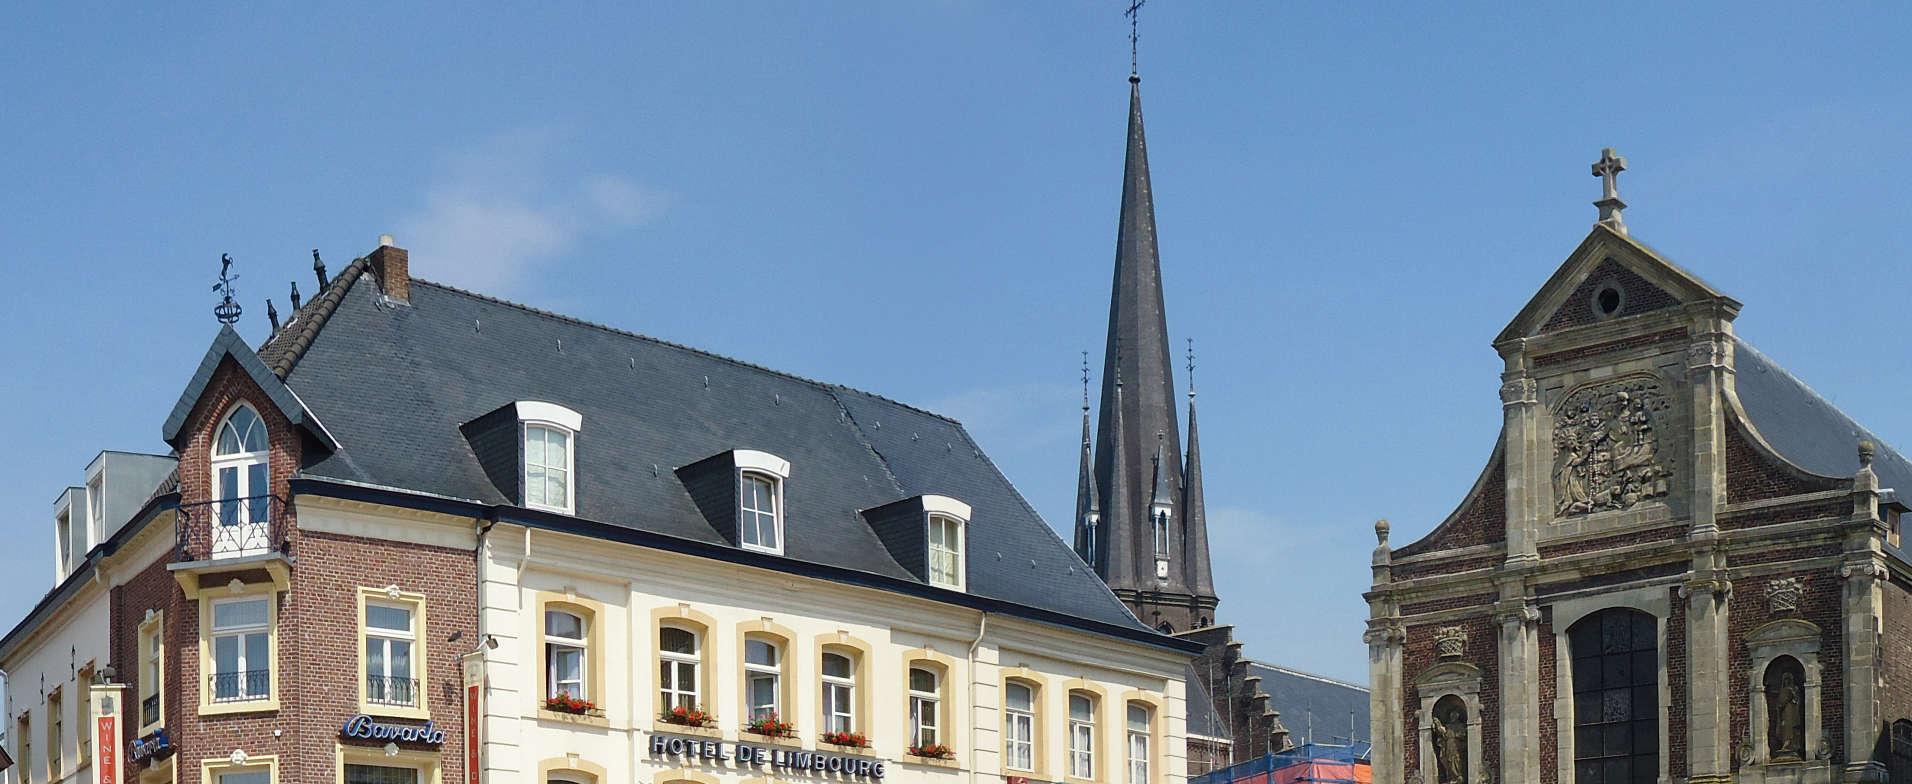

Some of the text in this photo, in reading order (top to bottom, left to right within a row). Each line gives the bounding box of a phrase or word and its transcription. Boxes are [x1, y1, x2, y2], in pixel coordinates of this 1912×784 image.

[101, 721, 112, 765] WINE
[346, 714, 447, 744] Bavaria
[651, 735, 885, 779] HOTEL DE LIMBOURG
